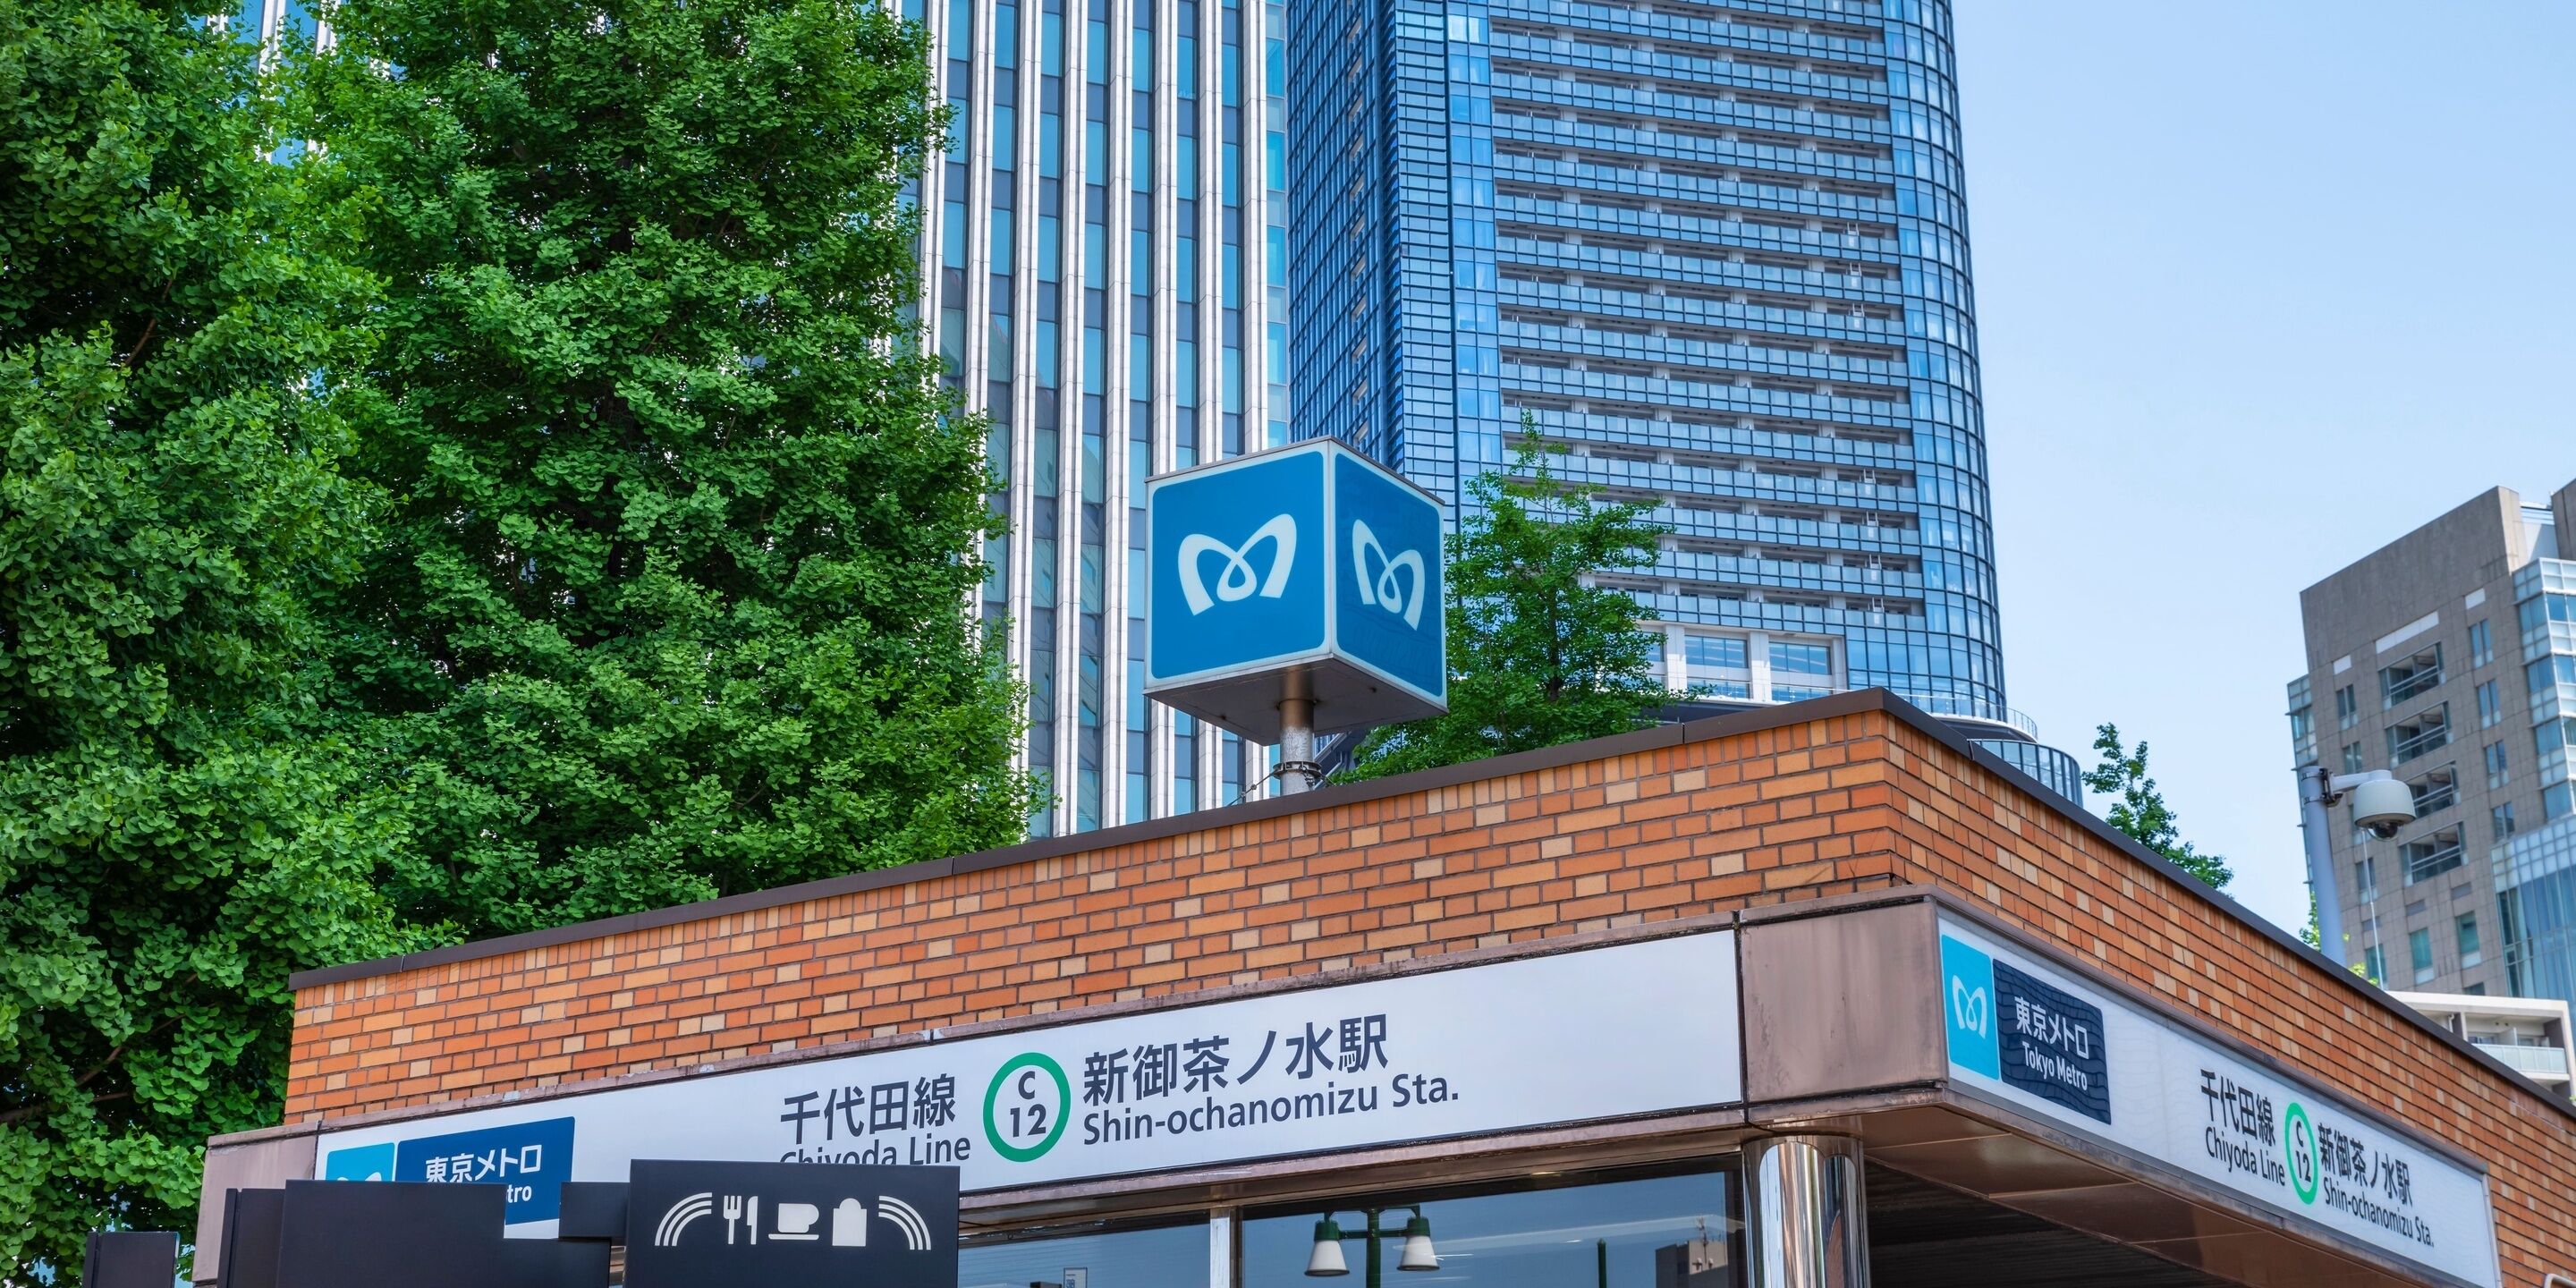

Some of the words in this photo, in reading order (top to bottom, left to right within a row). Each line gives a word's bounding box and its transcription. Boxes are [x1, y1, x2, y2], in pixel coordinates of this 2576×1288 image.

[2014, 996, 2089, 1060] 東京メトロ
[1017, 1071, 1037, 1100] C
[1083, 1013, 1388, 1106] 新御茶ノ水駅
[2022, 1041, 2055, 1080] Tokyo
[2057, 1056, 2088, 1091] Metro
[780, 1073, 956, 1145] 千代田線
[1009, 1103, 1046, 1138] 12
[1083, 1083, 1377, 1146] Shin-ochanomizu
[1392, 1073, 1460, 1109] Sta.
[2200, 1069, 2275, 1147] 千代田線
[2296, 1121, 2304, 1148] C
[426, 1144, 542, 1182] 東京メトロ
[910, 1133, 970, 1165] Line
[2206, 1126, 2258, 1173] Chiyoda
[2261, 1148, 2285, 1186] Line
[2295, 1150, 2311, 1182] 12
[2318, 1123, 2413, 1208] 新御茶ノ水駅
[506, 1184, 532, 1203] tro
[2323, 1177, 2413, 1239] Shin-ochanomizu
[2415, 1216, 2435, 1248] Sta.
